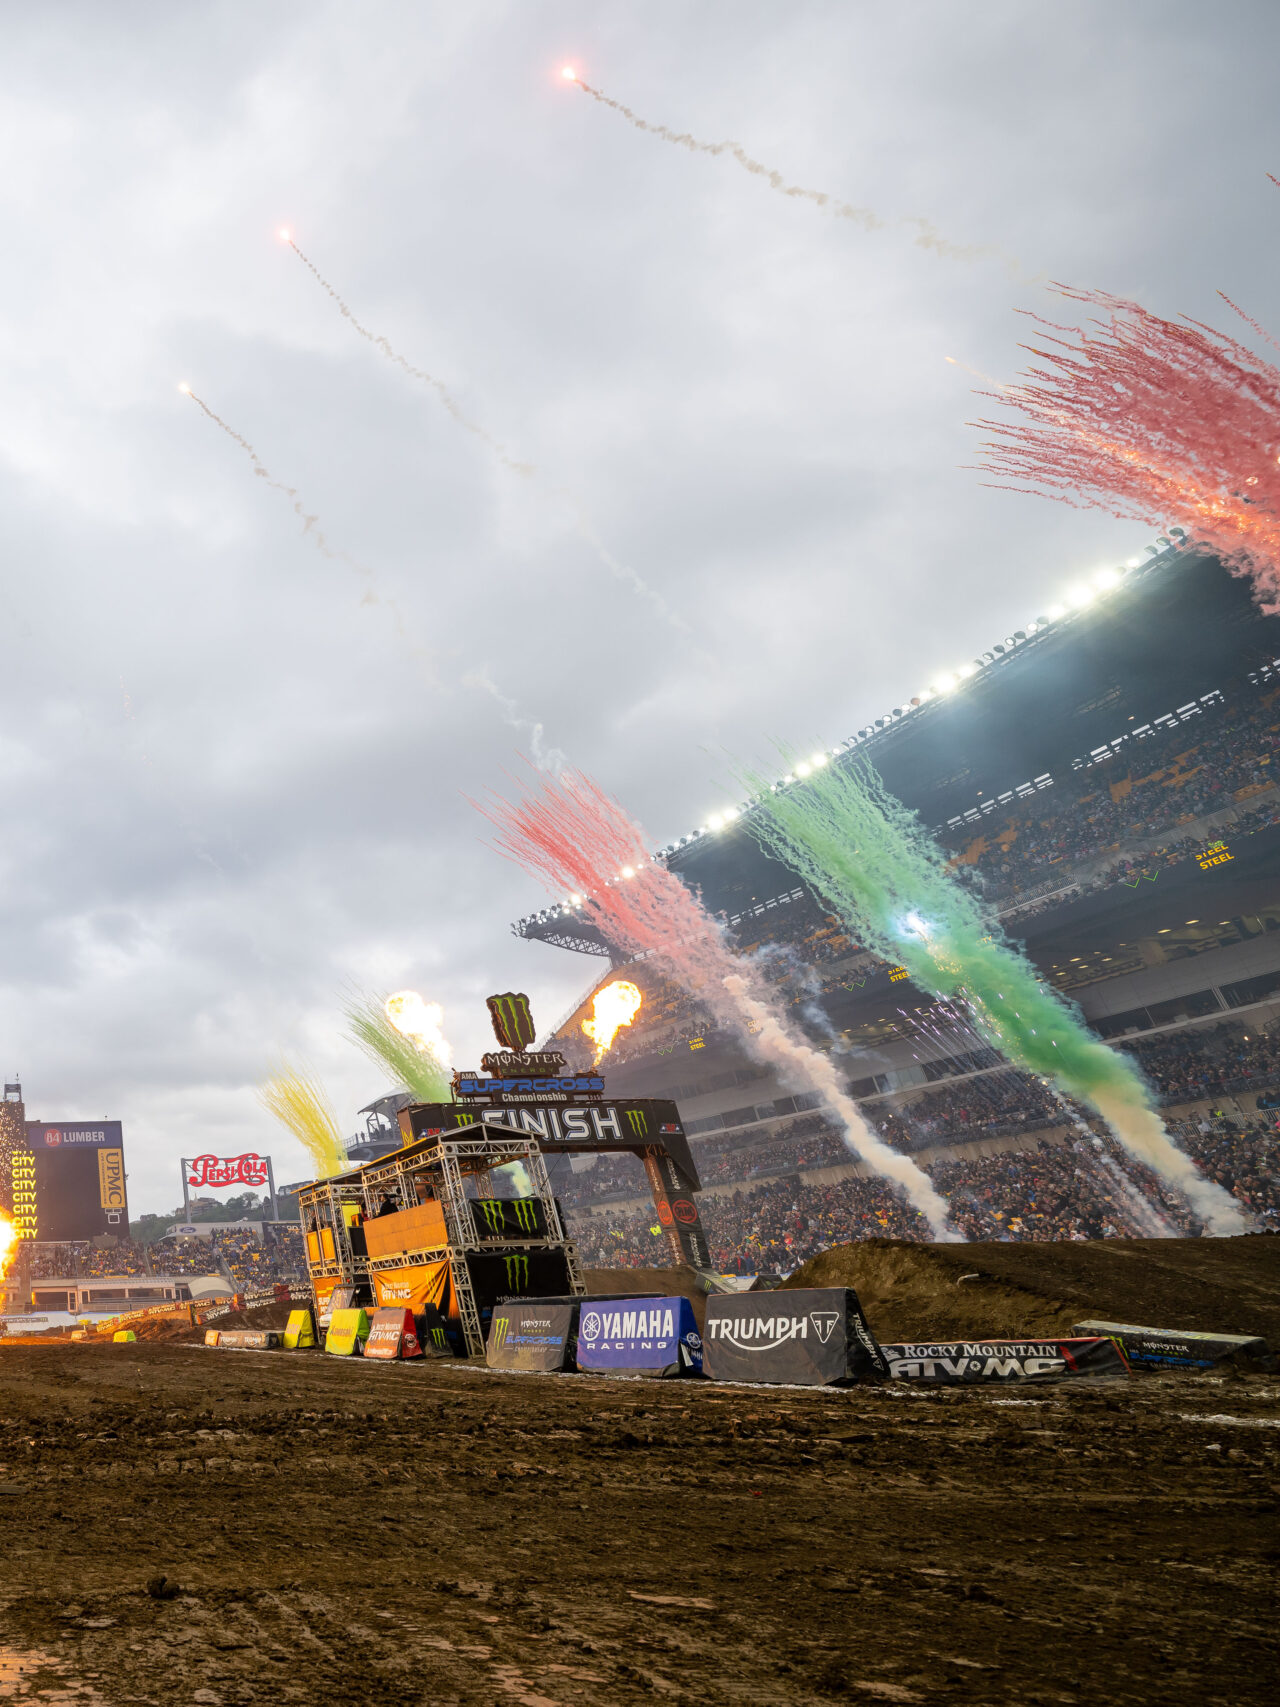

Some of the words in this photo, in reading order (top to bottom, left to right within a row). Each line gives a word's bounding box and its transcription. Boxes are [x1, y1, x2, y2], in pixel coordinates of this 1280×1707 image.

[1199, 852, 1235, 870] STEEL
[890, 971, 911, 982] STEEL
[690, 1042, 706, 1051] STEEL
[486, 1053, 565, 1066] MONSTER
[461, 1072, 478, 1080] AMA
[459, 1077, 604, 1093] SUPERCROSS
[502, 1092, 567, 1102] Championship
[482, 1107, 624, 1141] FINISH
[63, 1131, 105, 1143] LUMBER
[12, 1156, 35, 1166] CITY
[12, 1168, 36, 1178] CITY
[105, 1152, 122, 1205] UPMC
[12, 1180, 36, 1190] CITY
[13, 1192, 37, 1202] CITY
[13, 1204, 37, 1214] CITY
[520, 1319, 551, 1328] MONSTER
[603, 1309, 674, 1339] YAMAHA
[708, 1317, 808, 1351] TRIUMPH
[852, 1312, 878, 1359] TRIUMPH
[586, 1341, 667, 1350] RACING
[904, 1345, 958, 1358] ROCKY
[962, 1344, 1057, 1357] MOUNTAIN
[1142, 1342, 1189, 1353] MONSTER
